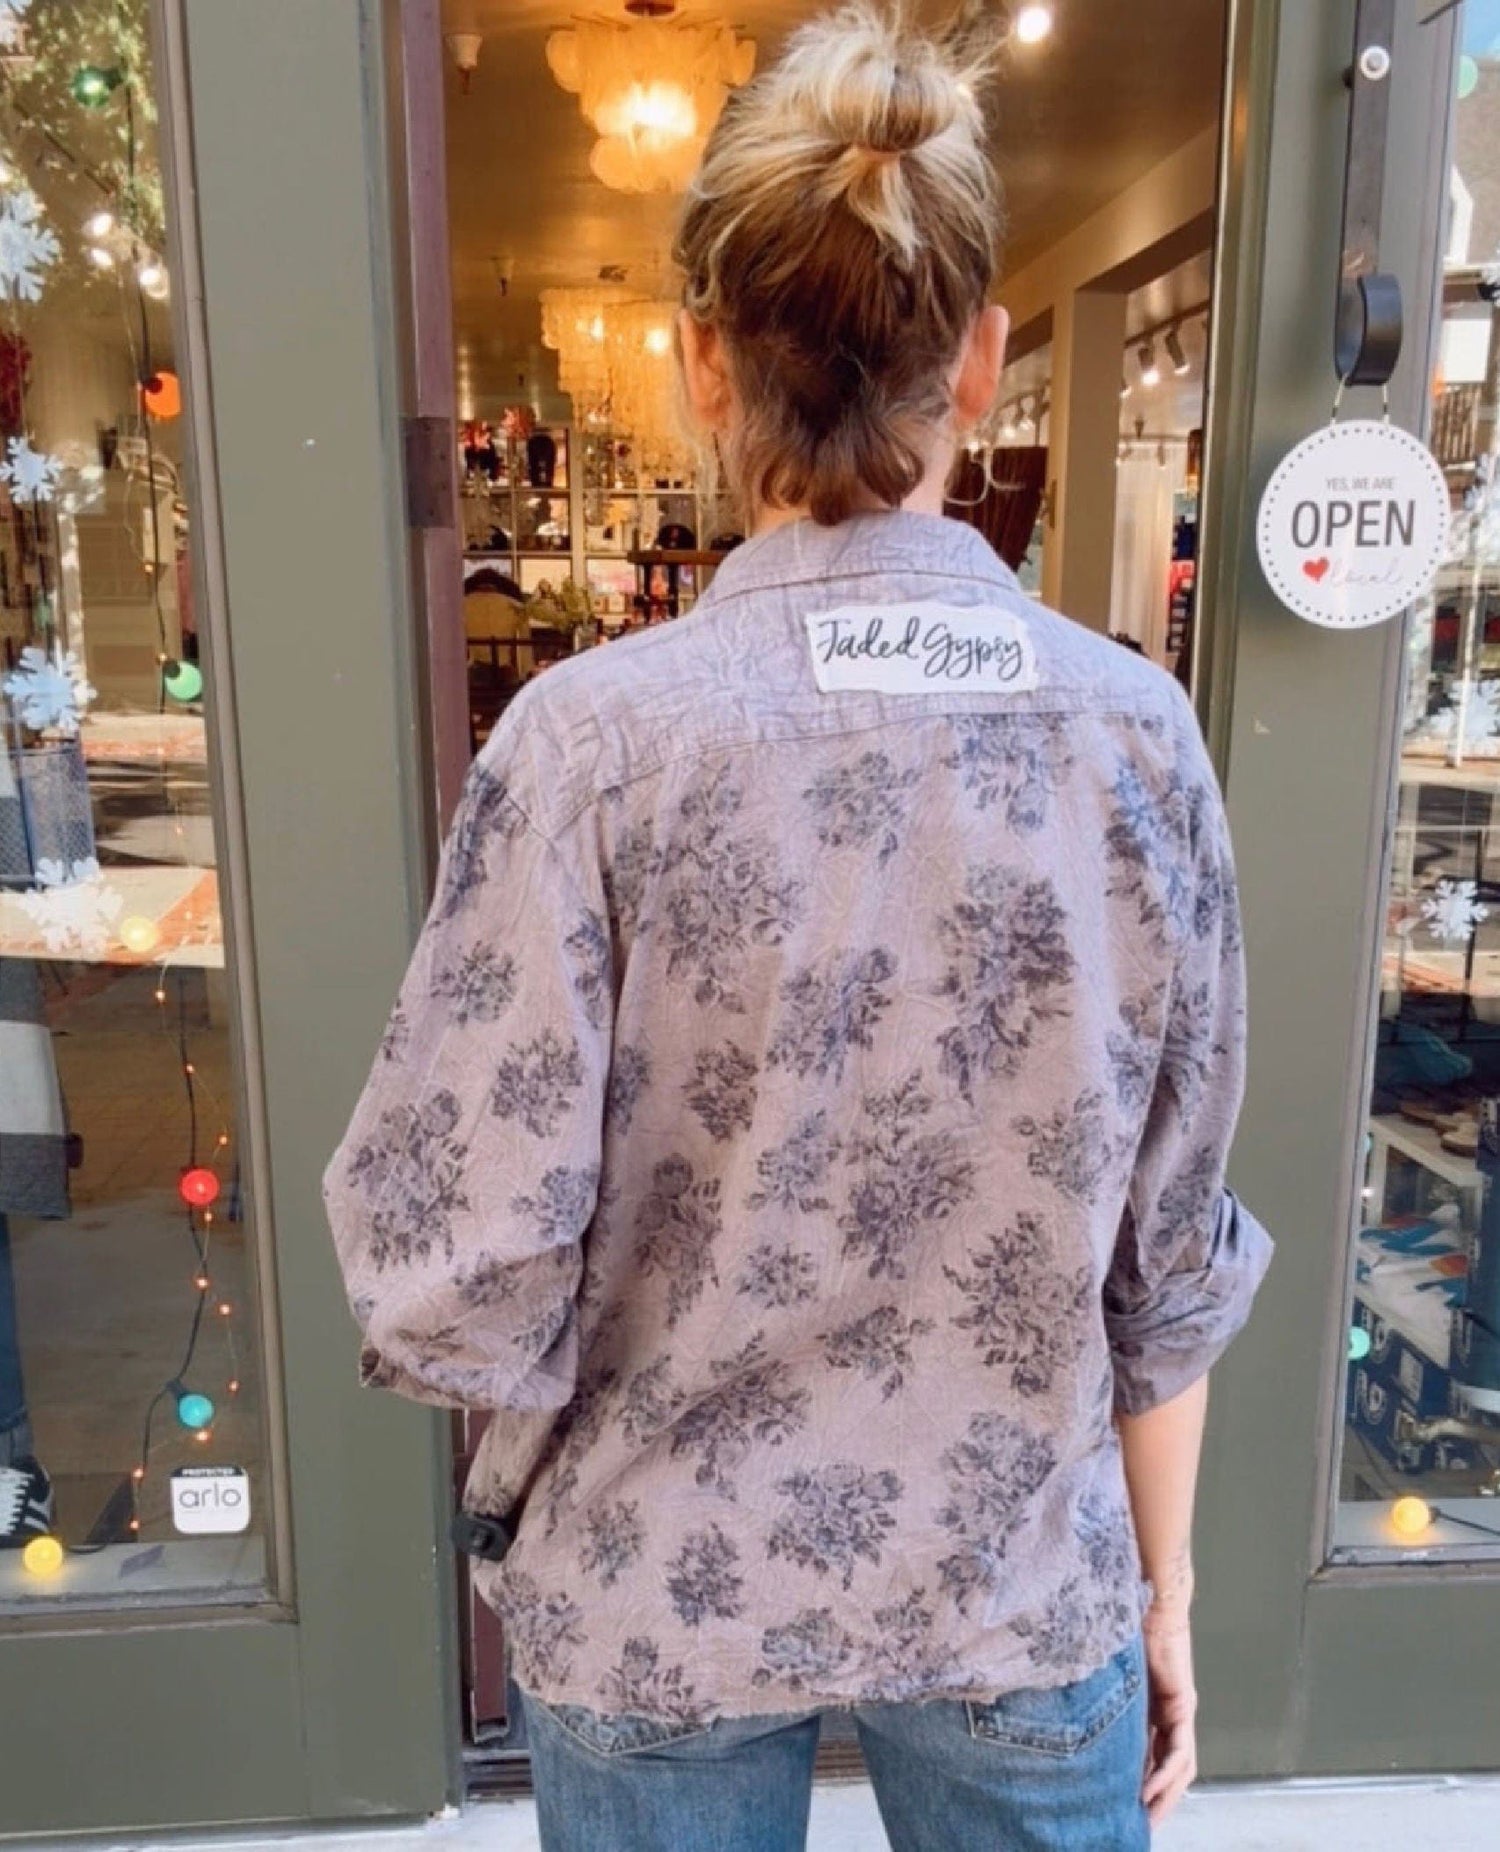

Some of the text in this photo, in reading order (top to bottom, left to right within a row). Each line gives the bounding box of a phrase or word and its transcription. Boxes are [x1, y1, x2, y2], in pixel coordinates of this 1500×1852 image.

[1373, 477, 1395, 489] ARE
[1291, 500, 1416, 548] OPEN
[816, 615, 1022, 681] Jaded Gypsy
[179, 1481, 242, 1508] arlo
